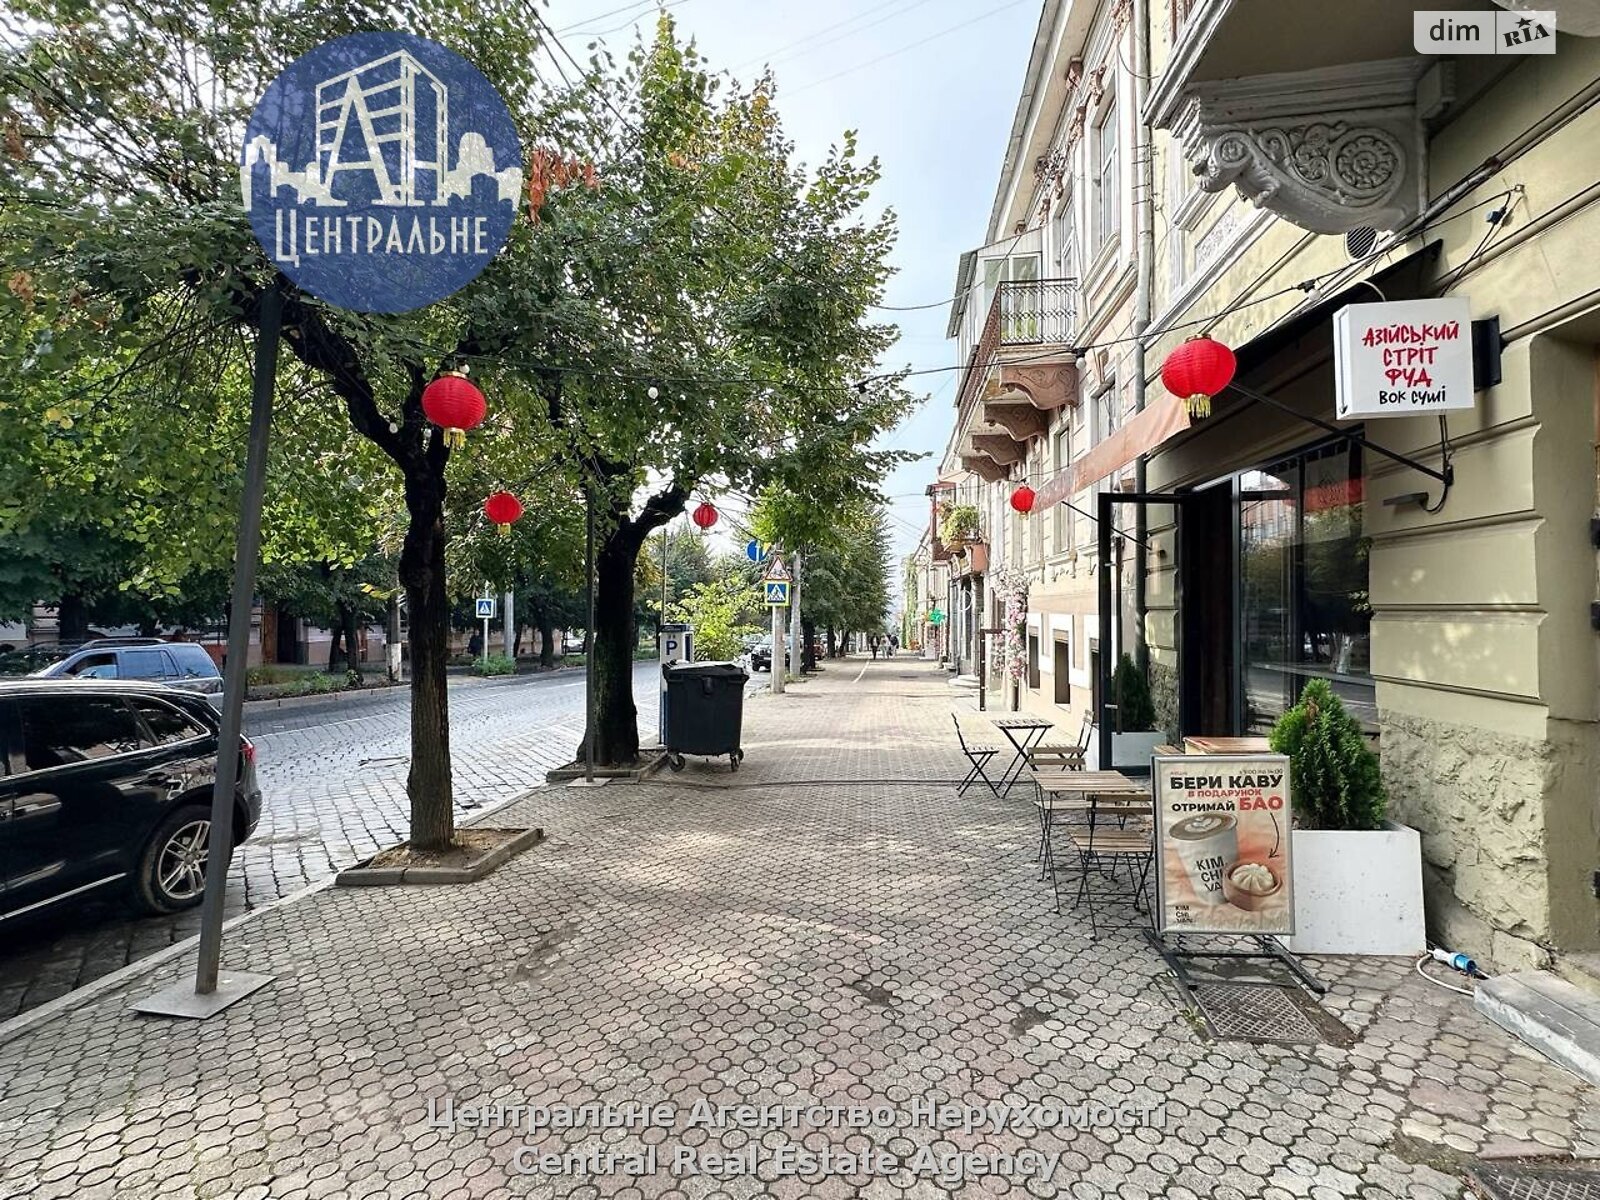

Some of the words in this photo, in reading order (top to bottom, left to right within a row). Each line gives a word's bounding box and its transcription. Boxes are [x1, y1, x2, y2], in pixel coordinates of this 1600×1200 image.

[1361, 321, 1459, 347] АЗІЙСЬКИЙ
[1382, 342, 1439, 367] СТРІТ
[1384, 367, 1433, 388] ФУД
[666, 641, 677, 655] P
[1170, 776, 1222, 790] БЕРИ
[1229, 774, 1284, 789] КАВУ
[1197, 789, 1263, 799] ПОДАРУНОК
[1171, 800, 1236, 812] ОТРИМАЙ
[1239, 796, 1284, 811] БАО
